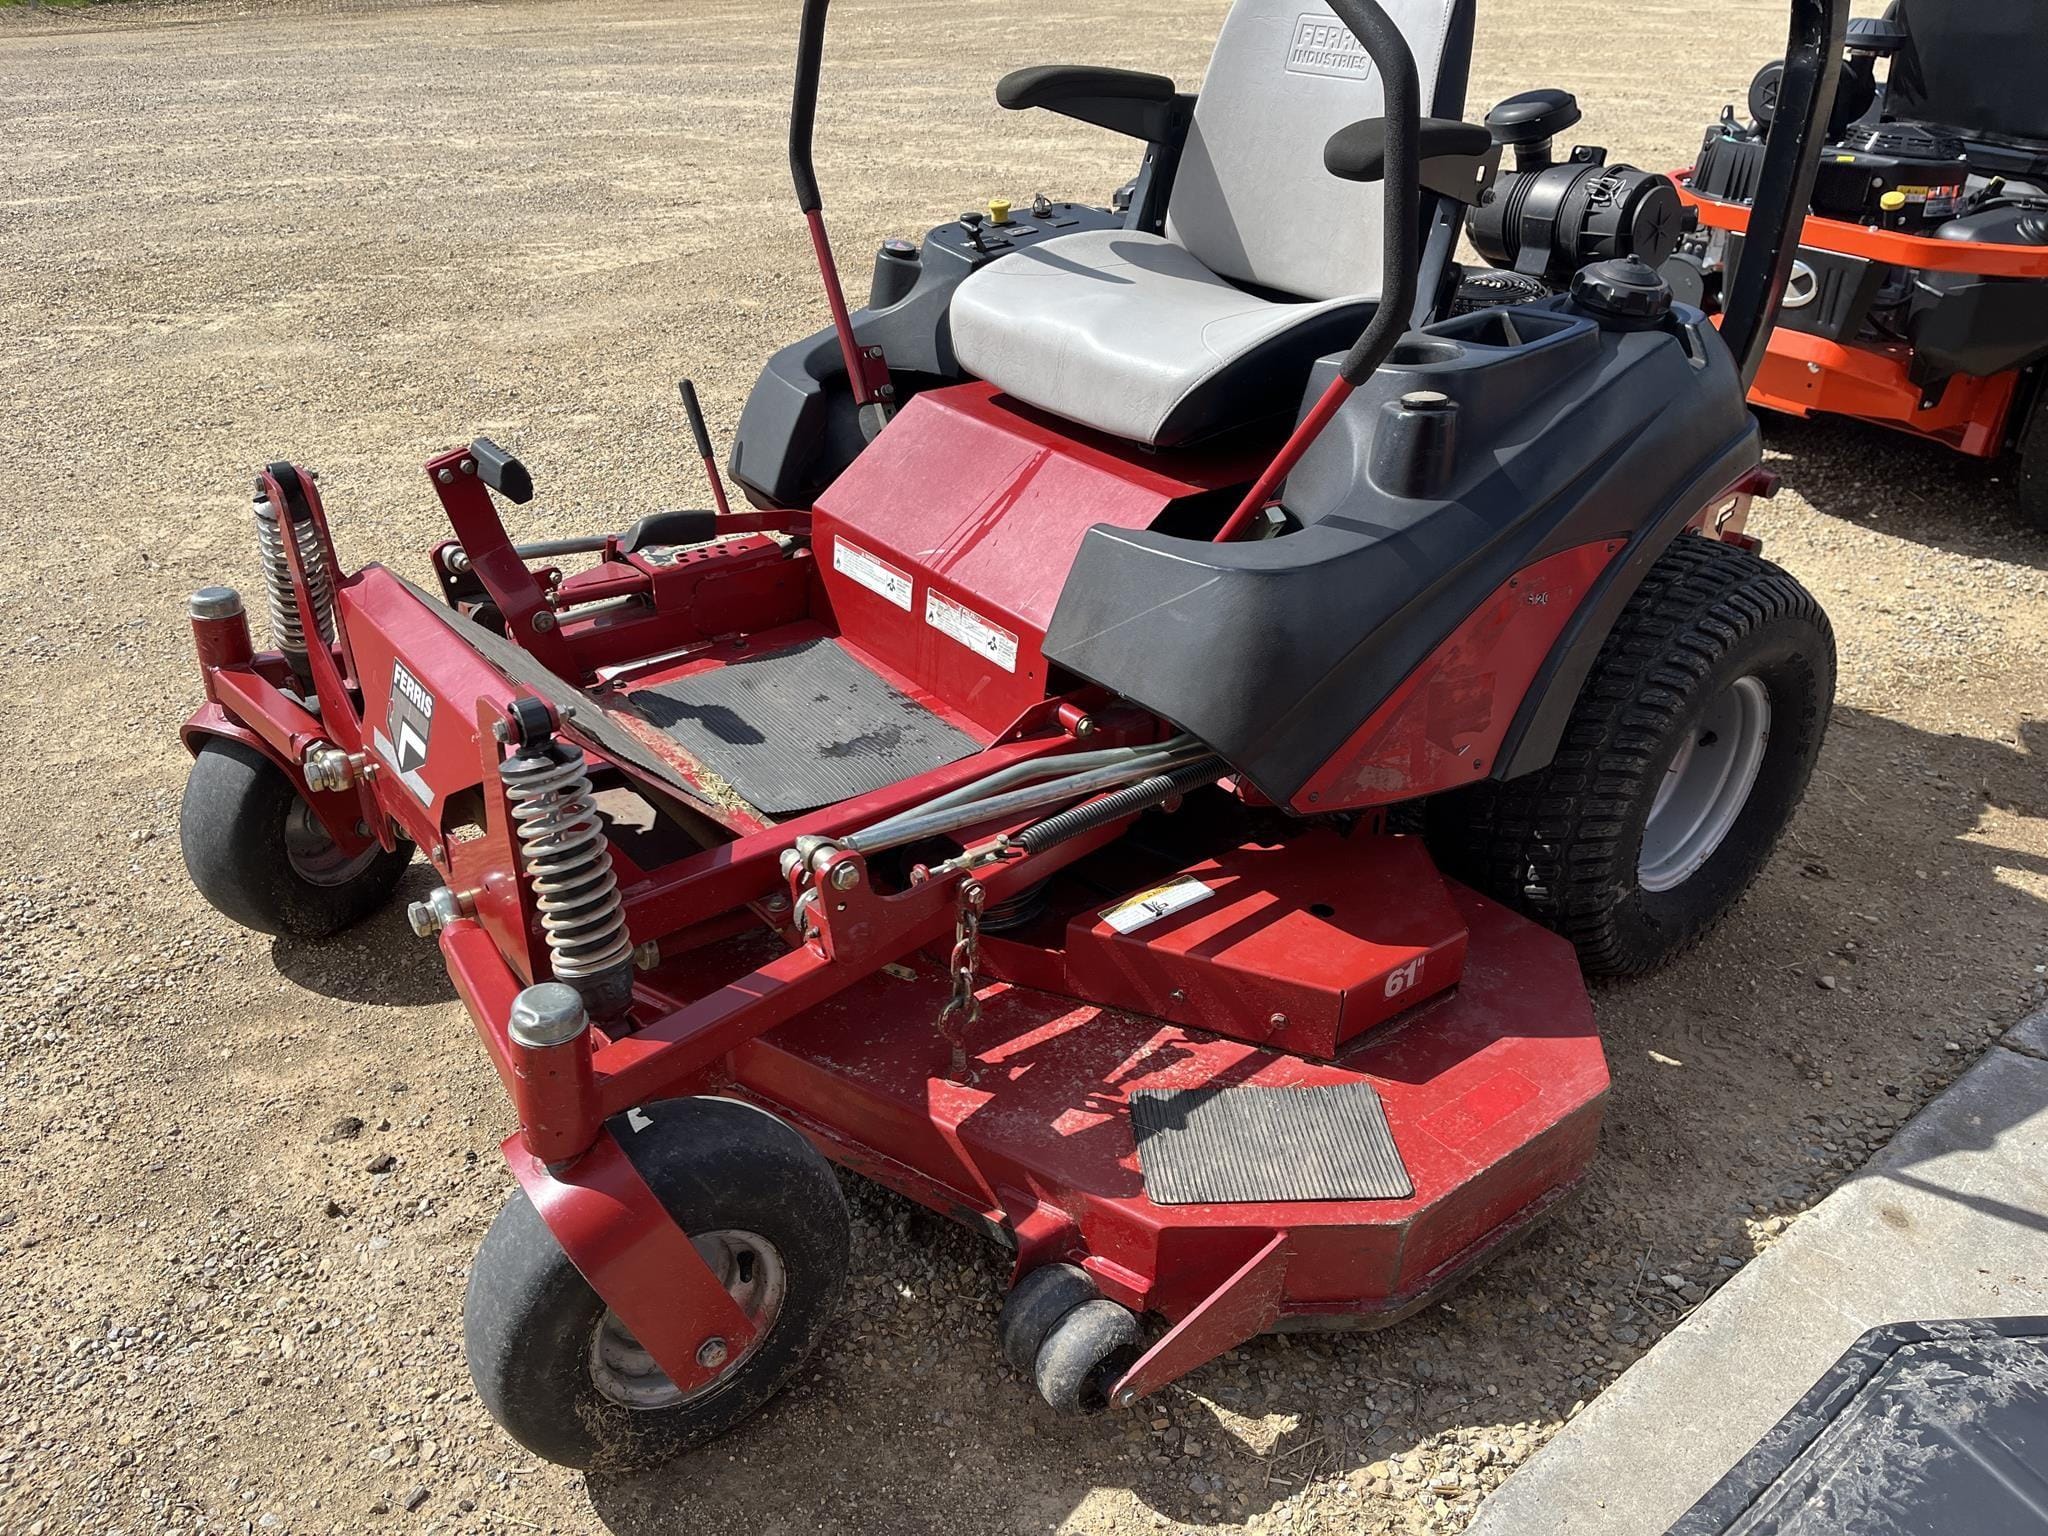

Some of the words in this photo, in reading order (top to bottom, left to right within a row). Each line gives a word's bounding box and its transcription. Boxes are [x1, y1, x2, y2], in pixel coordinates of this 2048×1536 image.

[1297, 23, 1363, 52] FERRI
[1292, 48, 1367, 70] INDUSTRIES
[393, 664, 433, 719] FERRIS
[1384, 955, 1426, 998] 61"
